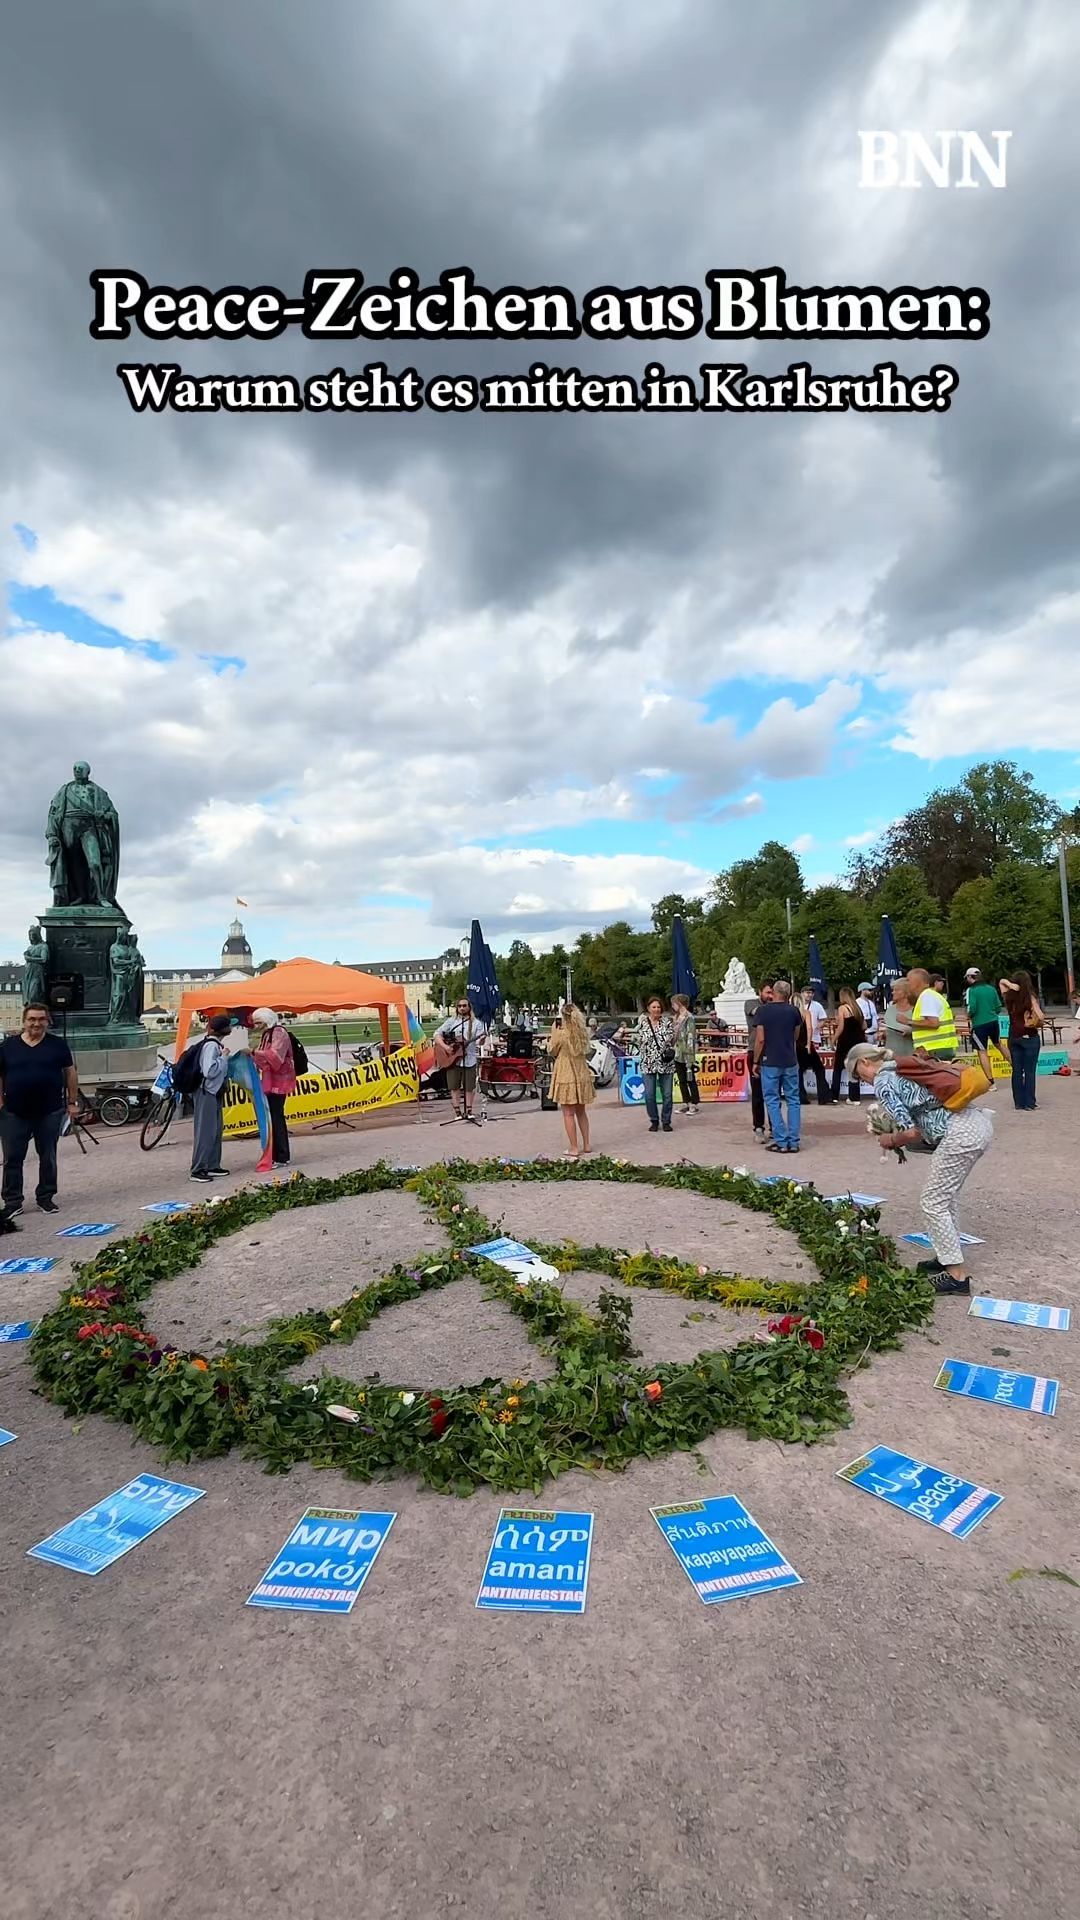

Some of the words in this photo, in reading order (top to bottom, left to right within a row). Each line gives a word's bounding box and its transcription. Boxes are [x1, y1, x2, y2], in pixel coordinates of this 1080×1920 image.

[363, 1063, 381, 1083] zu
[381, 1054, 417, 1081] Krieg
[654, 1502, 704, 1518] FRIEDEN
[907, 1475, 964, 1521] peace
[305, 1510, 358, 1521] FRIEDEN
[502, 1510, 555, 1522] FRIEDEN
[290, 1525, 382, 1556] мир
[682, 1540, 775, 1570] kapayapaan
[269, 1557, 367, 1586] pokój
[488, 1558, 585, 1582] amani
[695, 1564, 795, 1594] ANTIKRIEGSTAG
[255, 1585, 356, 1603] ANTIKRIEGSTAG
[480, 1586, 585, 1602] ANTIKRIEGSTAG
